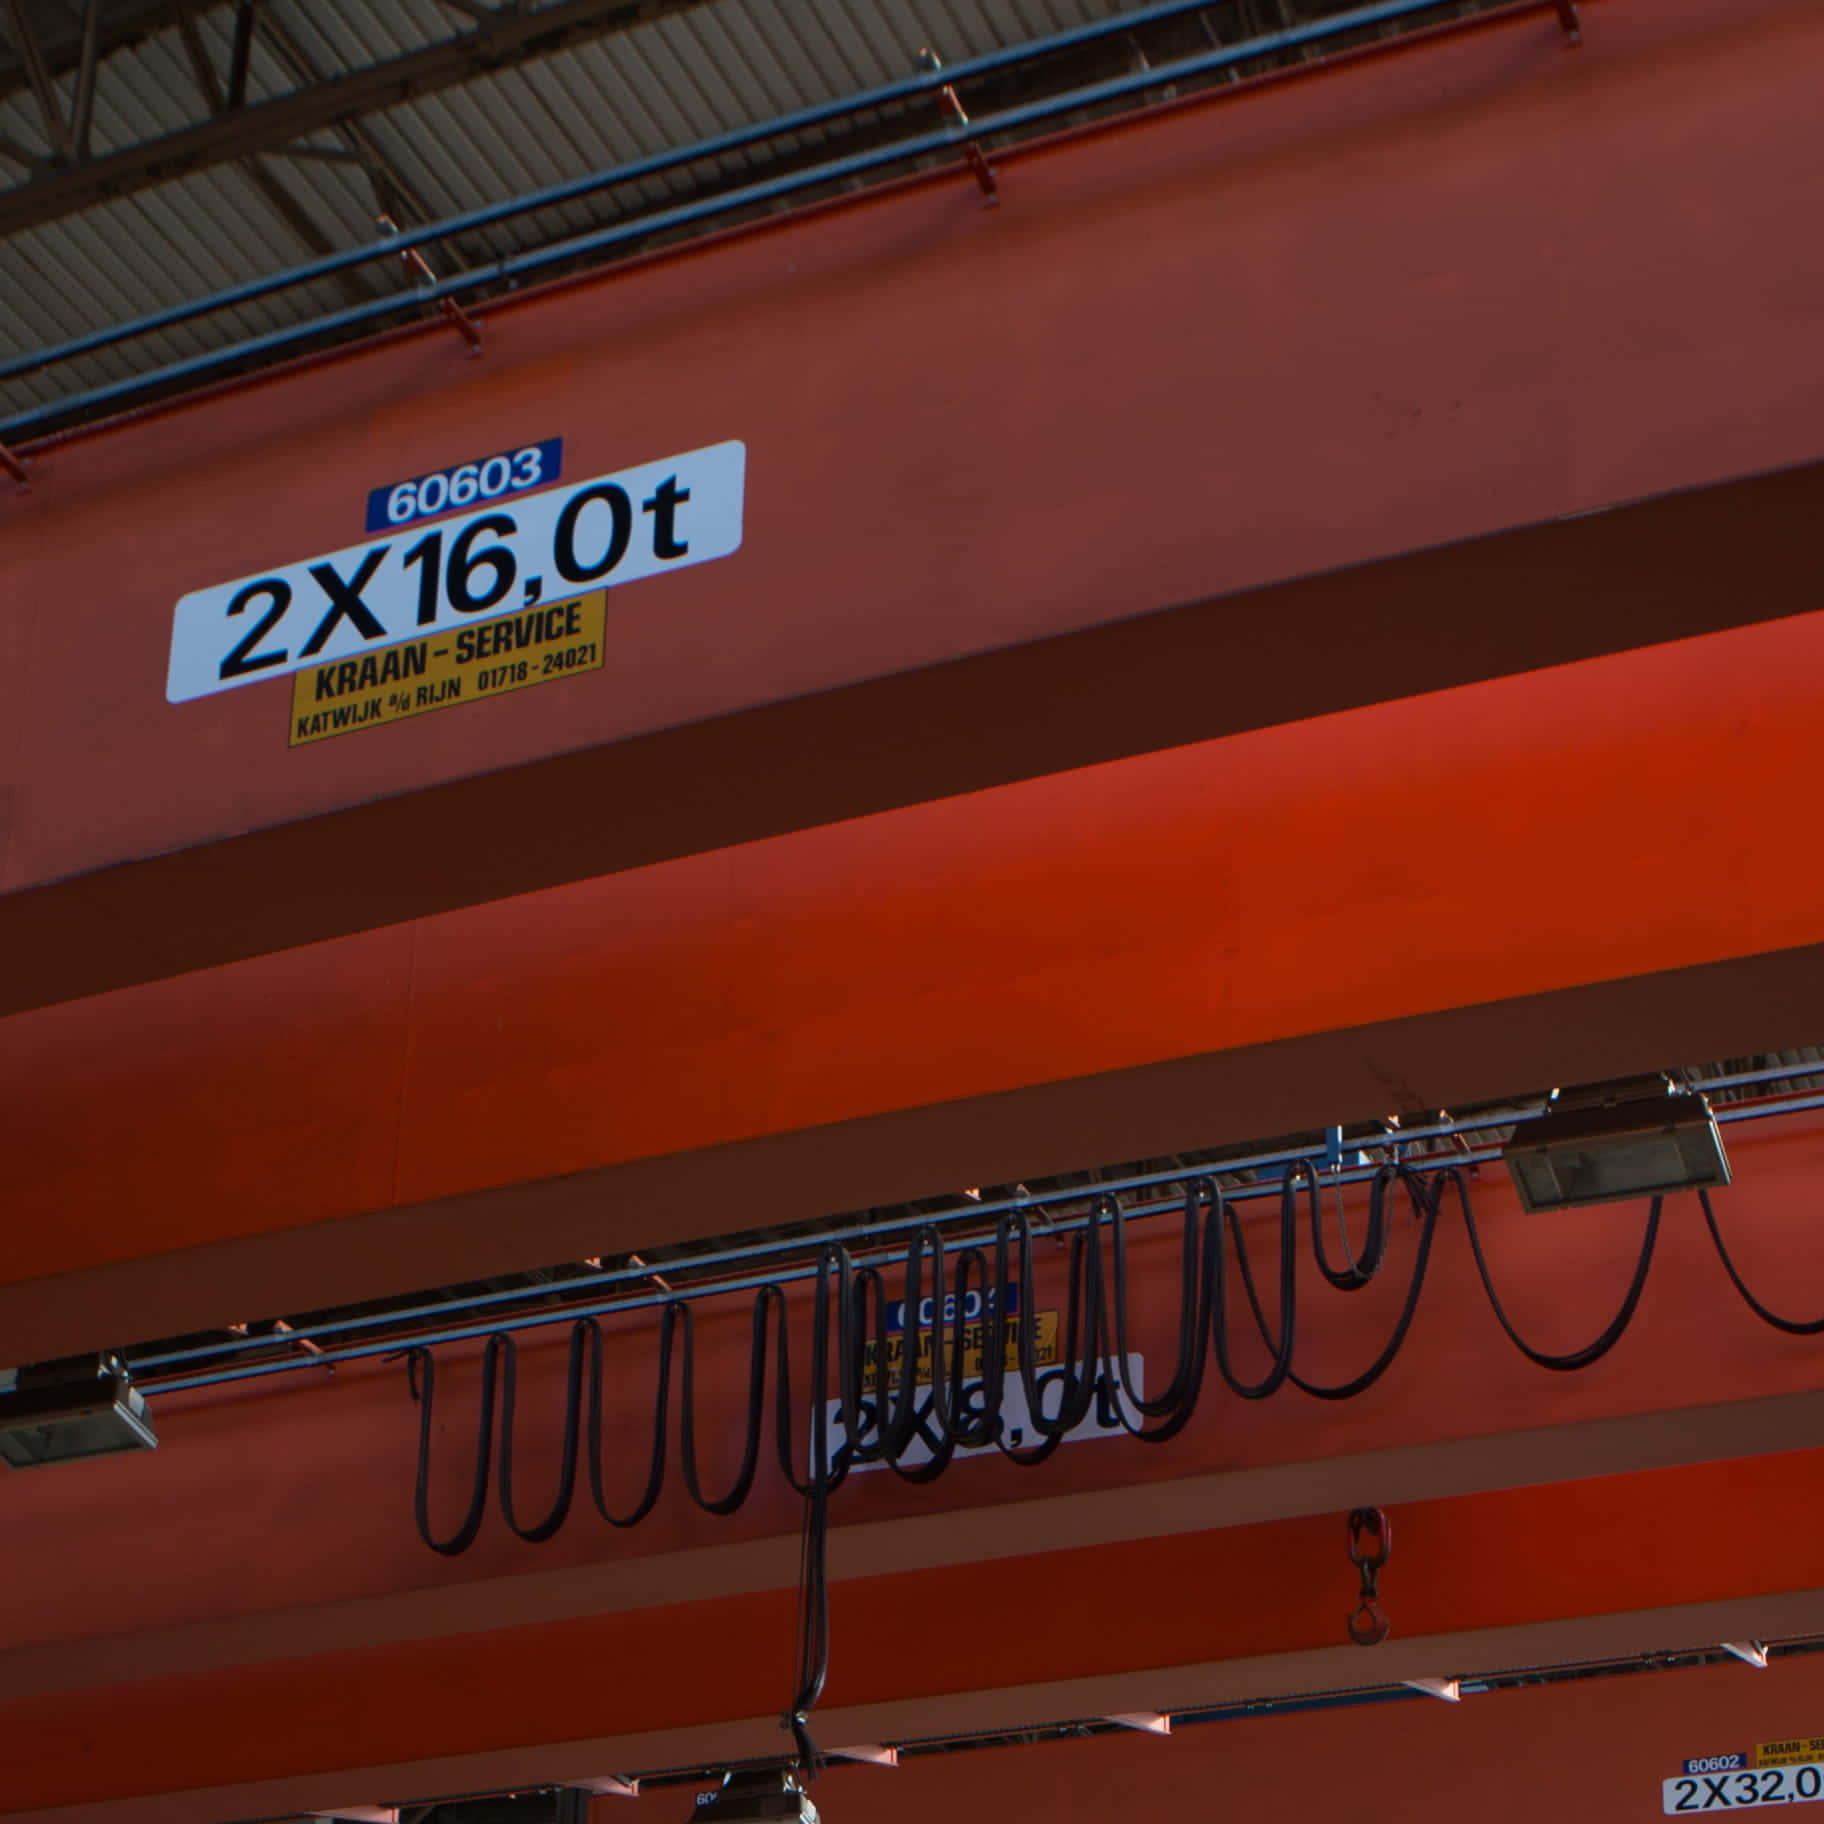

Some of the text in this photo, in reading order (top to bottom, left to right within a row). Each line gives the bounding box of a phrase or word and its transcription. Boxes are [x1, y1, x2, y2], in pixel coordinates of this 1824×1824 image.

[386, 447, 542, 524] 60603
[219, 474, 690, 680] 2X16,0t
[297, 698, 382, 738] KATWIJK
[416, 677, 461, 707] RIJN
[542, 643, 596, 675] 24021
[315, 643, 427, 701] KRAAN
[455, 601, 582, 664] SERVICE
[1688, 1755, 1740, 1773] 60602
[1764, 1741, 1801, 1754] KRAAN
